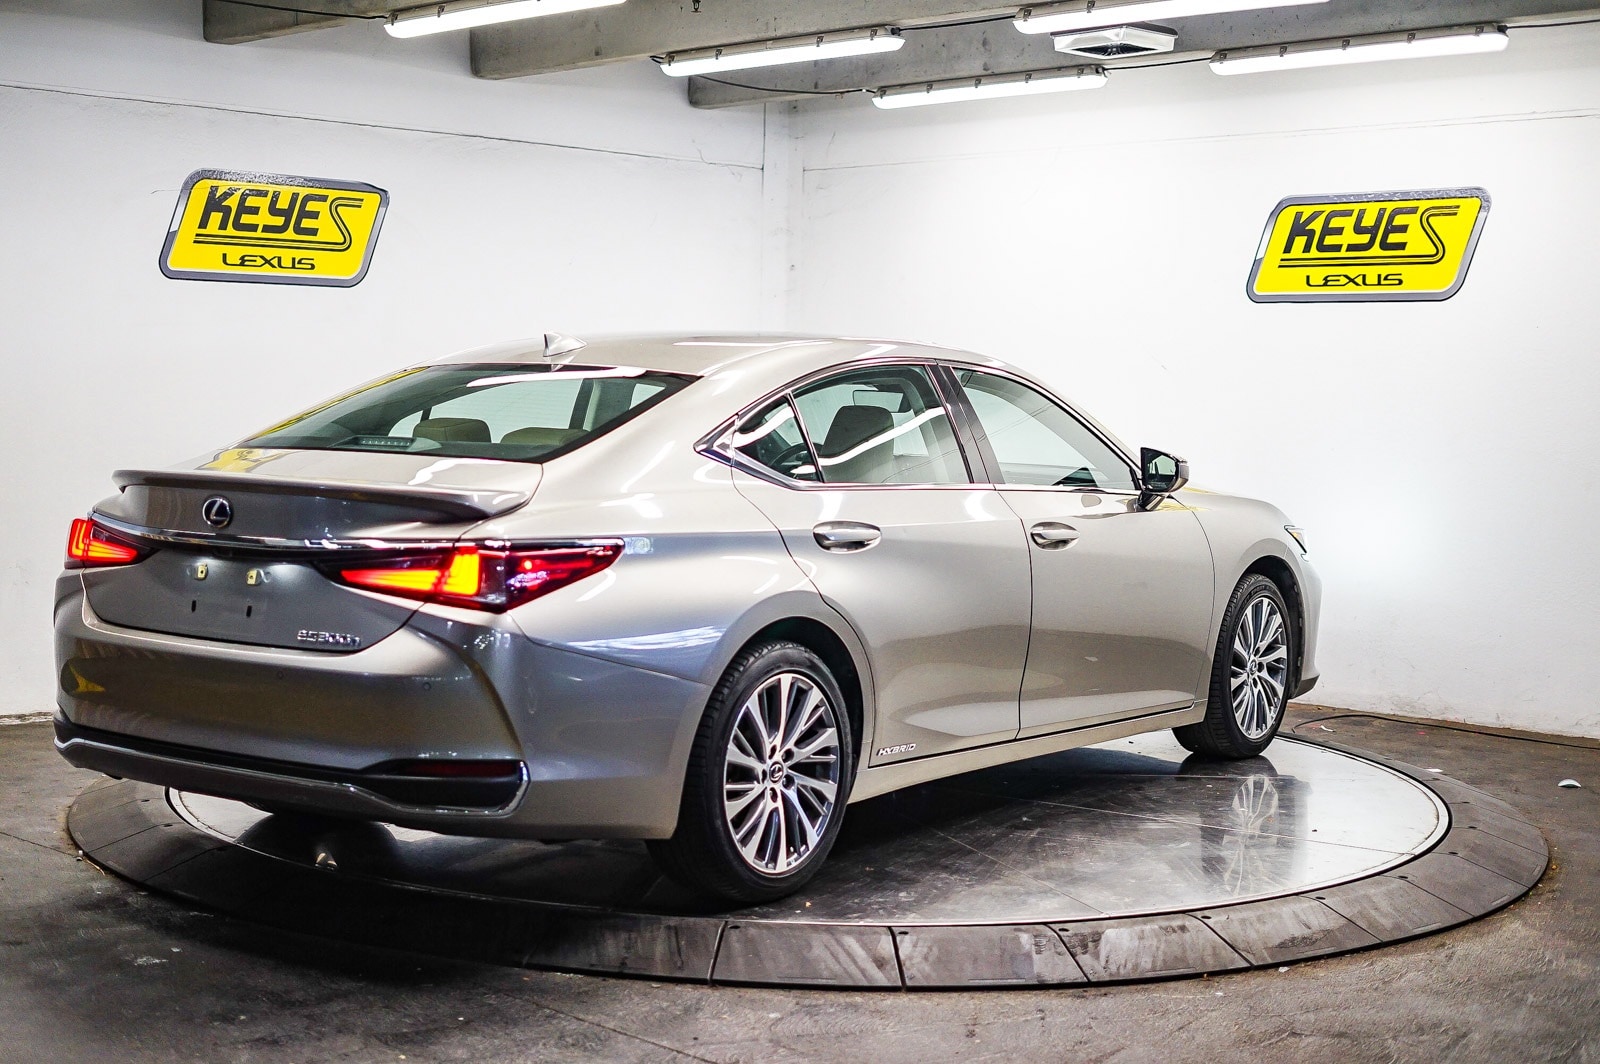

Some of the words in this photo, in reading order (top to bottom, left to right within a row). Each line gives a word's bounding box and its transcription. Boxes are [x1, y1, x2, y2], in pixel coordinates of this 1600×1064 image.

[196, 184, 364, 252] KEYES
[1281, 204, 1461, 267] KEYES
[221, 252, 316, 270] LEXUS
[1305, 272, 1404, 287] LEXUS
[877, 743, 916, 756] HYBRID
